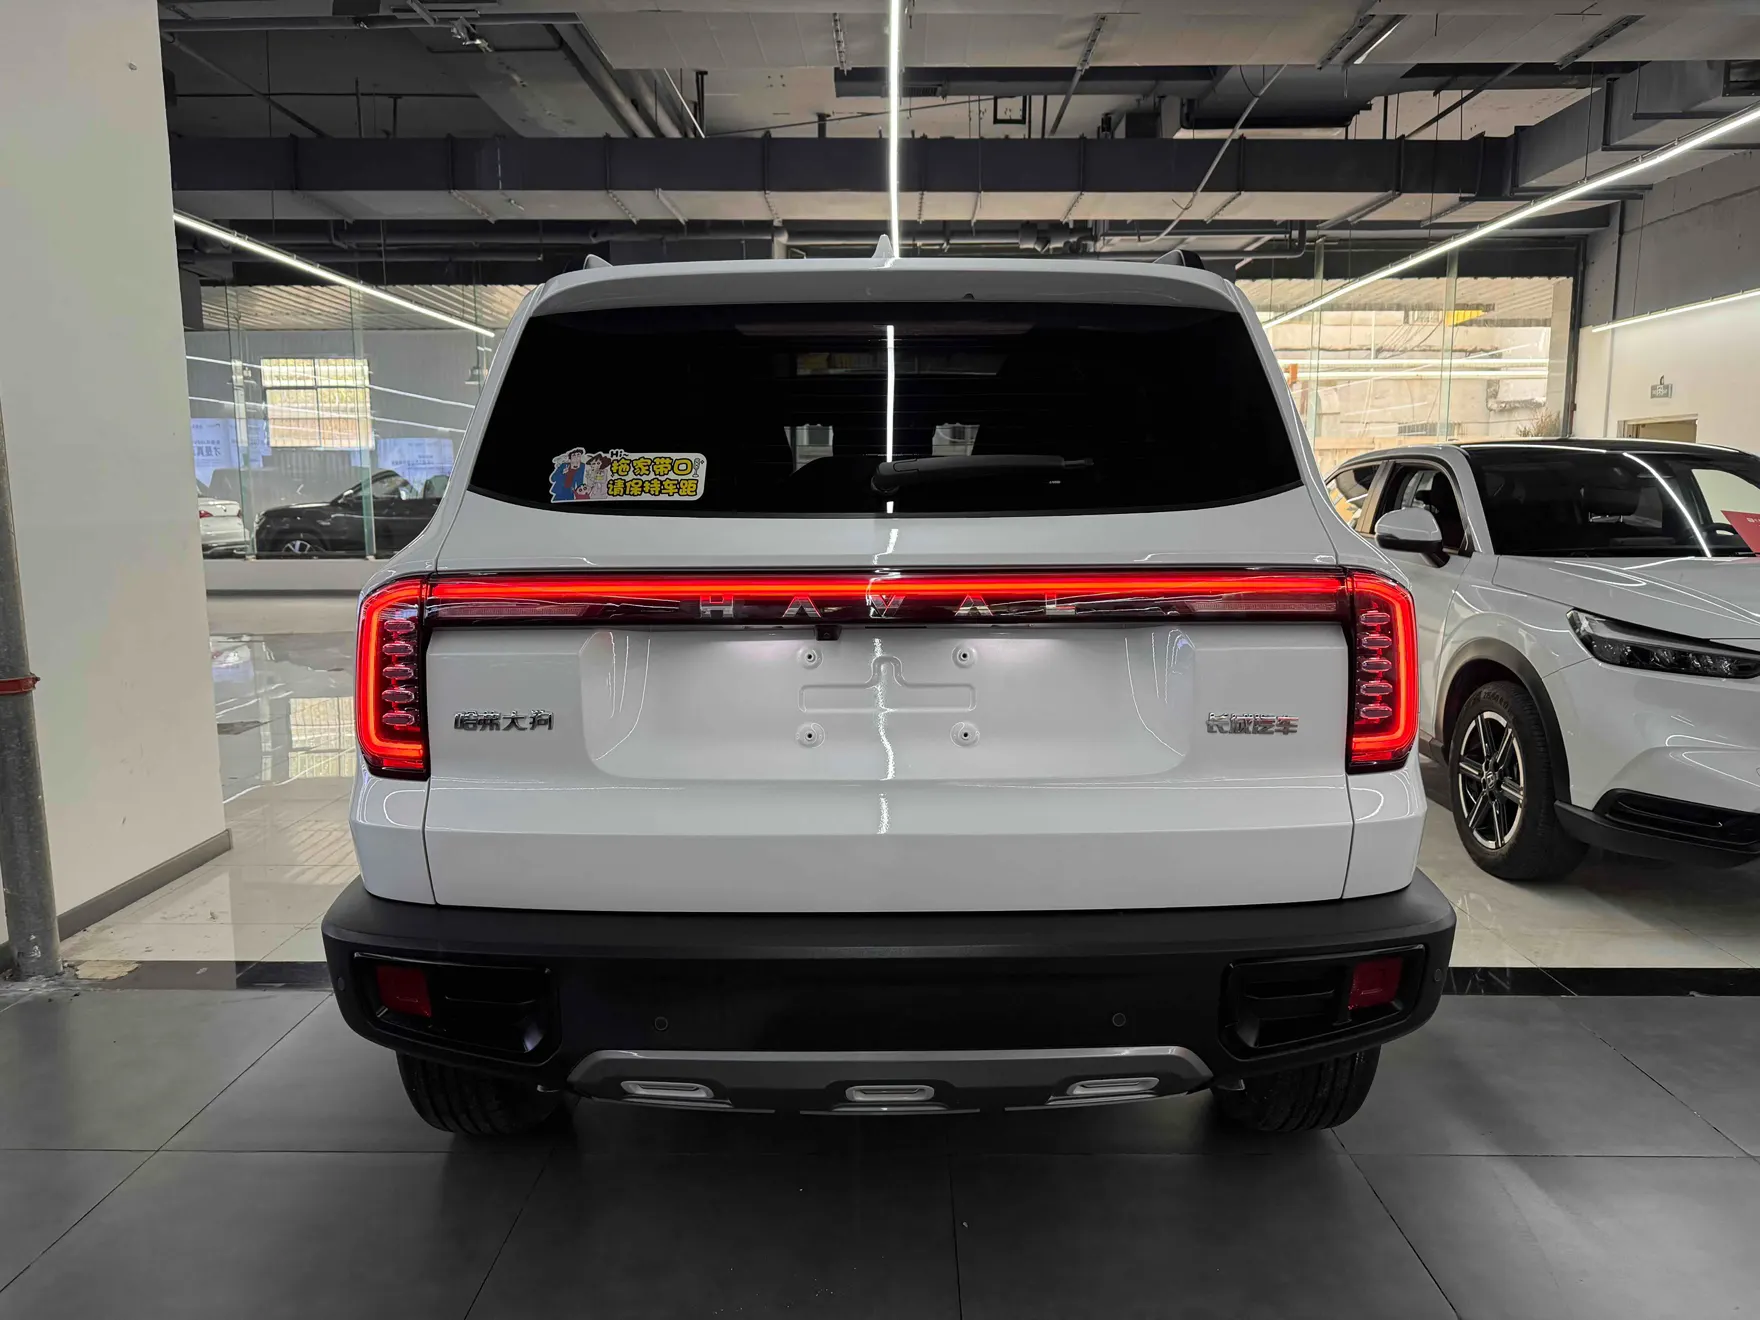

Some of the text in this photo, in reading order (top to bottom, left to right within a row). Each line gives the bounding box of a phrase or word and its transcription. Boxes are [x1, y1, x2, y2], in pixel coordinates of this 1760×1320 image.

[610, 456, 693, 477] 拖家带口
[607, 478, 699, 497] 请保持车距
[700, 593, 1077, 619] HAVAL
[453, 709, 555, 731] 哈弗大狗
[1205, 712, 1299, 735] 长城汽车
